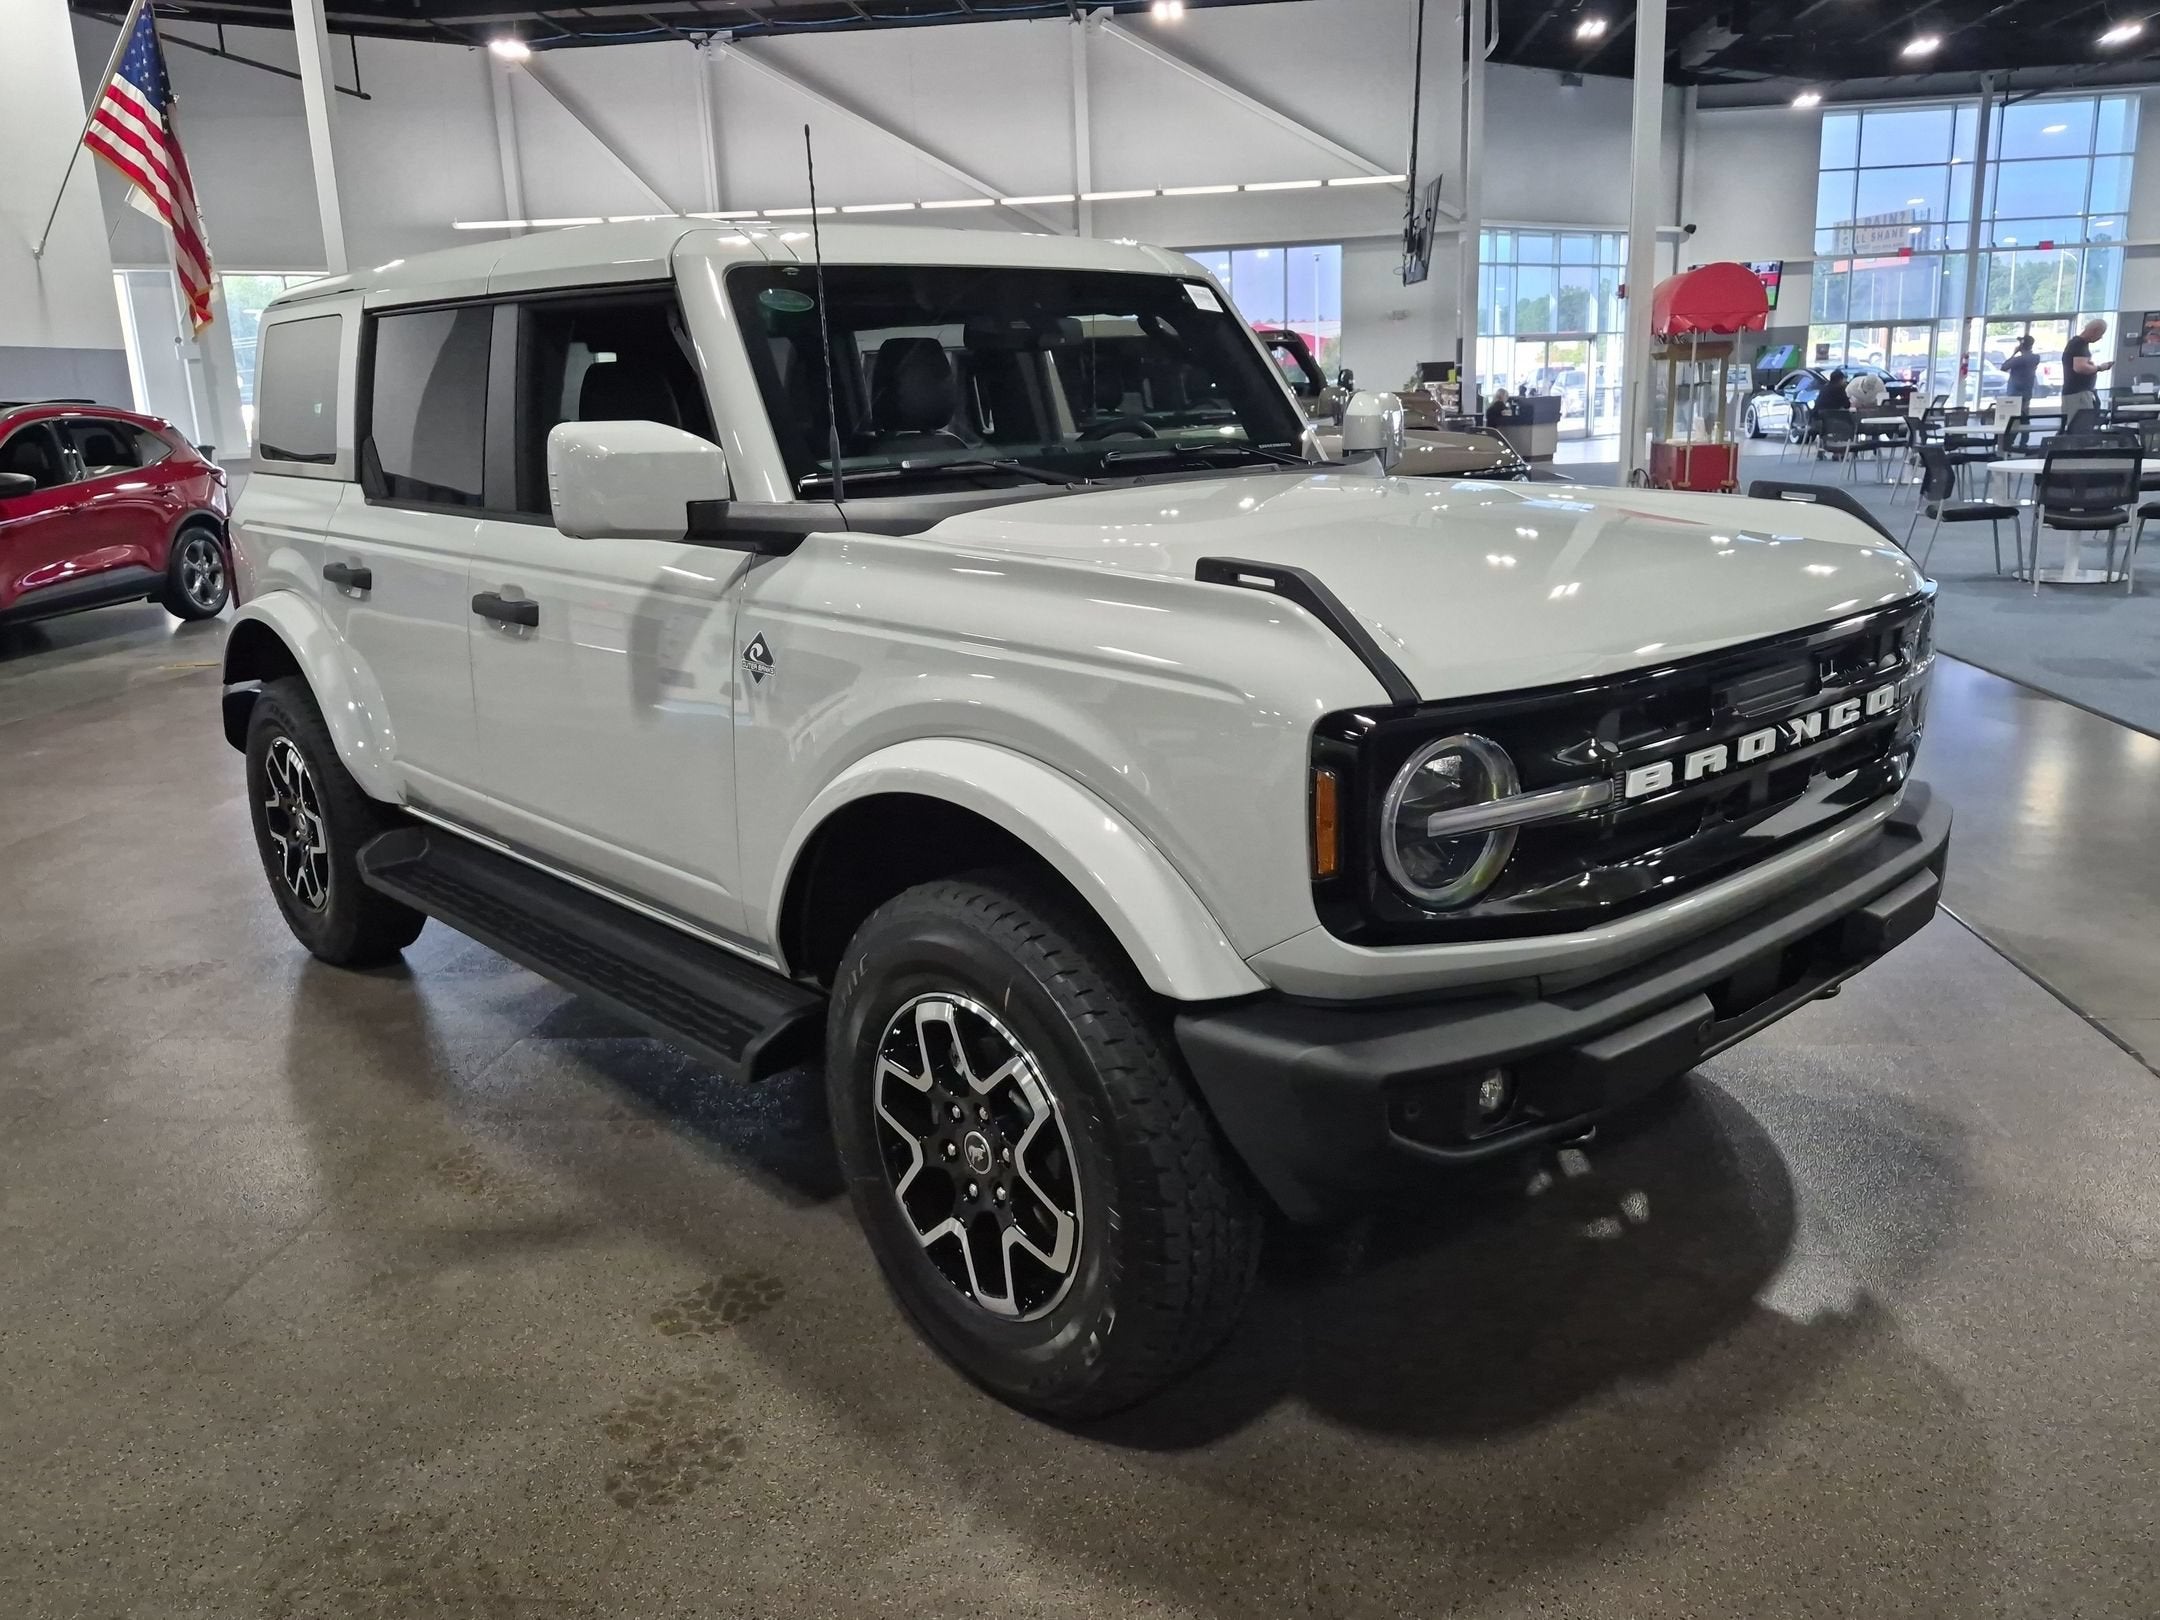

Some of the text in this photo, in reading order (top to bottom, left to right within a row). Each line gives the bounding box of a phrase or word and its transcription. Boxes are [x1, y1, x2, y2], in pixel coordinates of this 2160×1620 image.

[1842, 228, 1904, 246] CLL SHANE
[758, 663, 774, 673] BANKS
[1625, 684, 1896, 799] BRONCO
